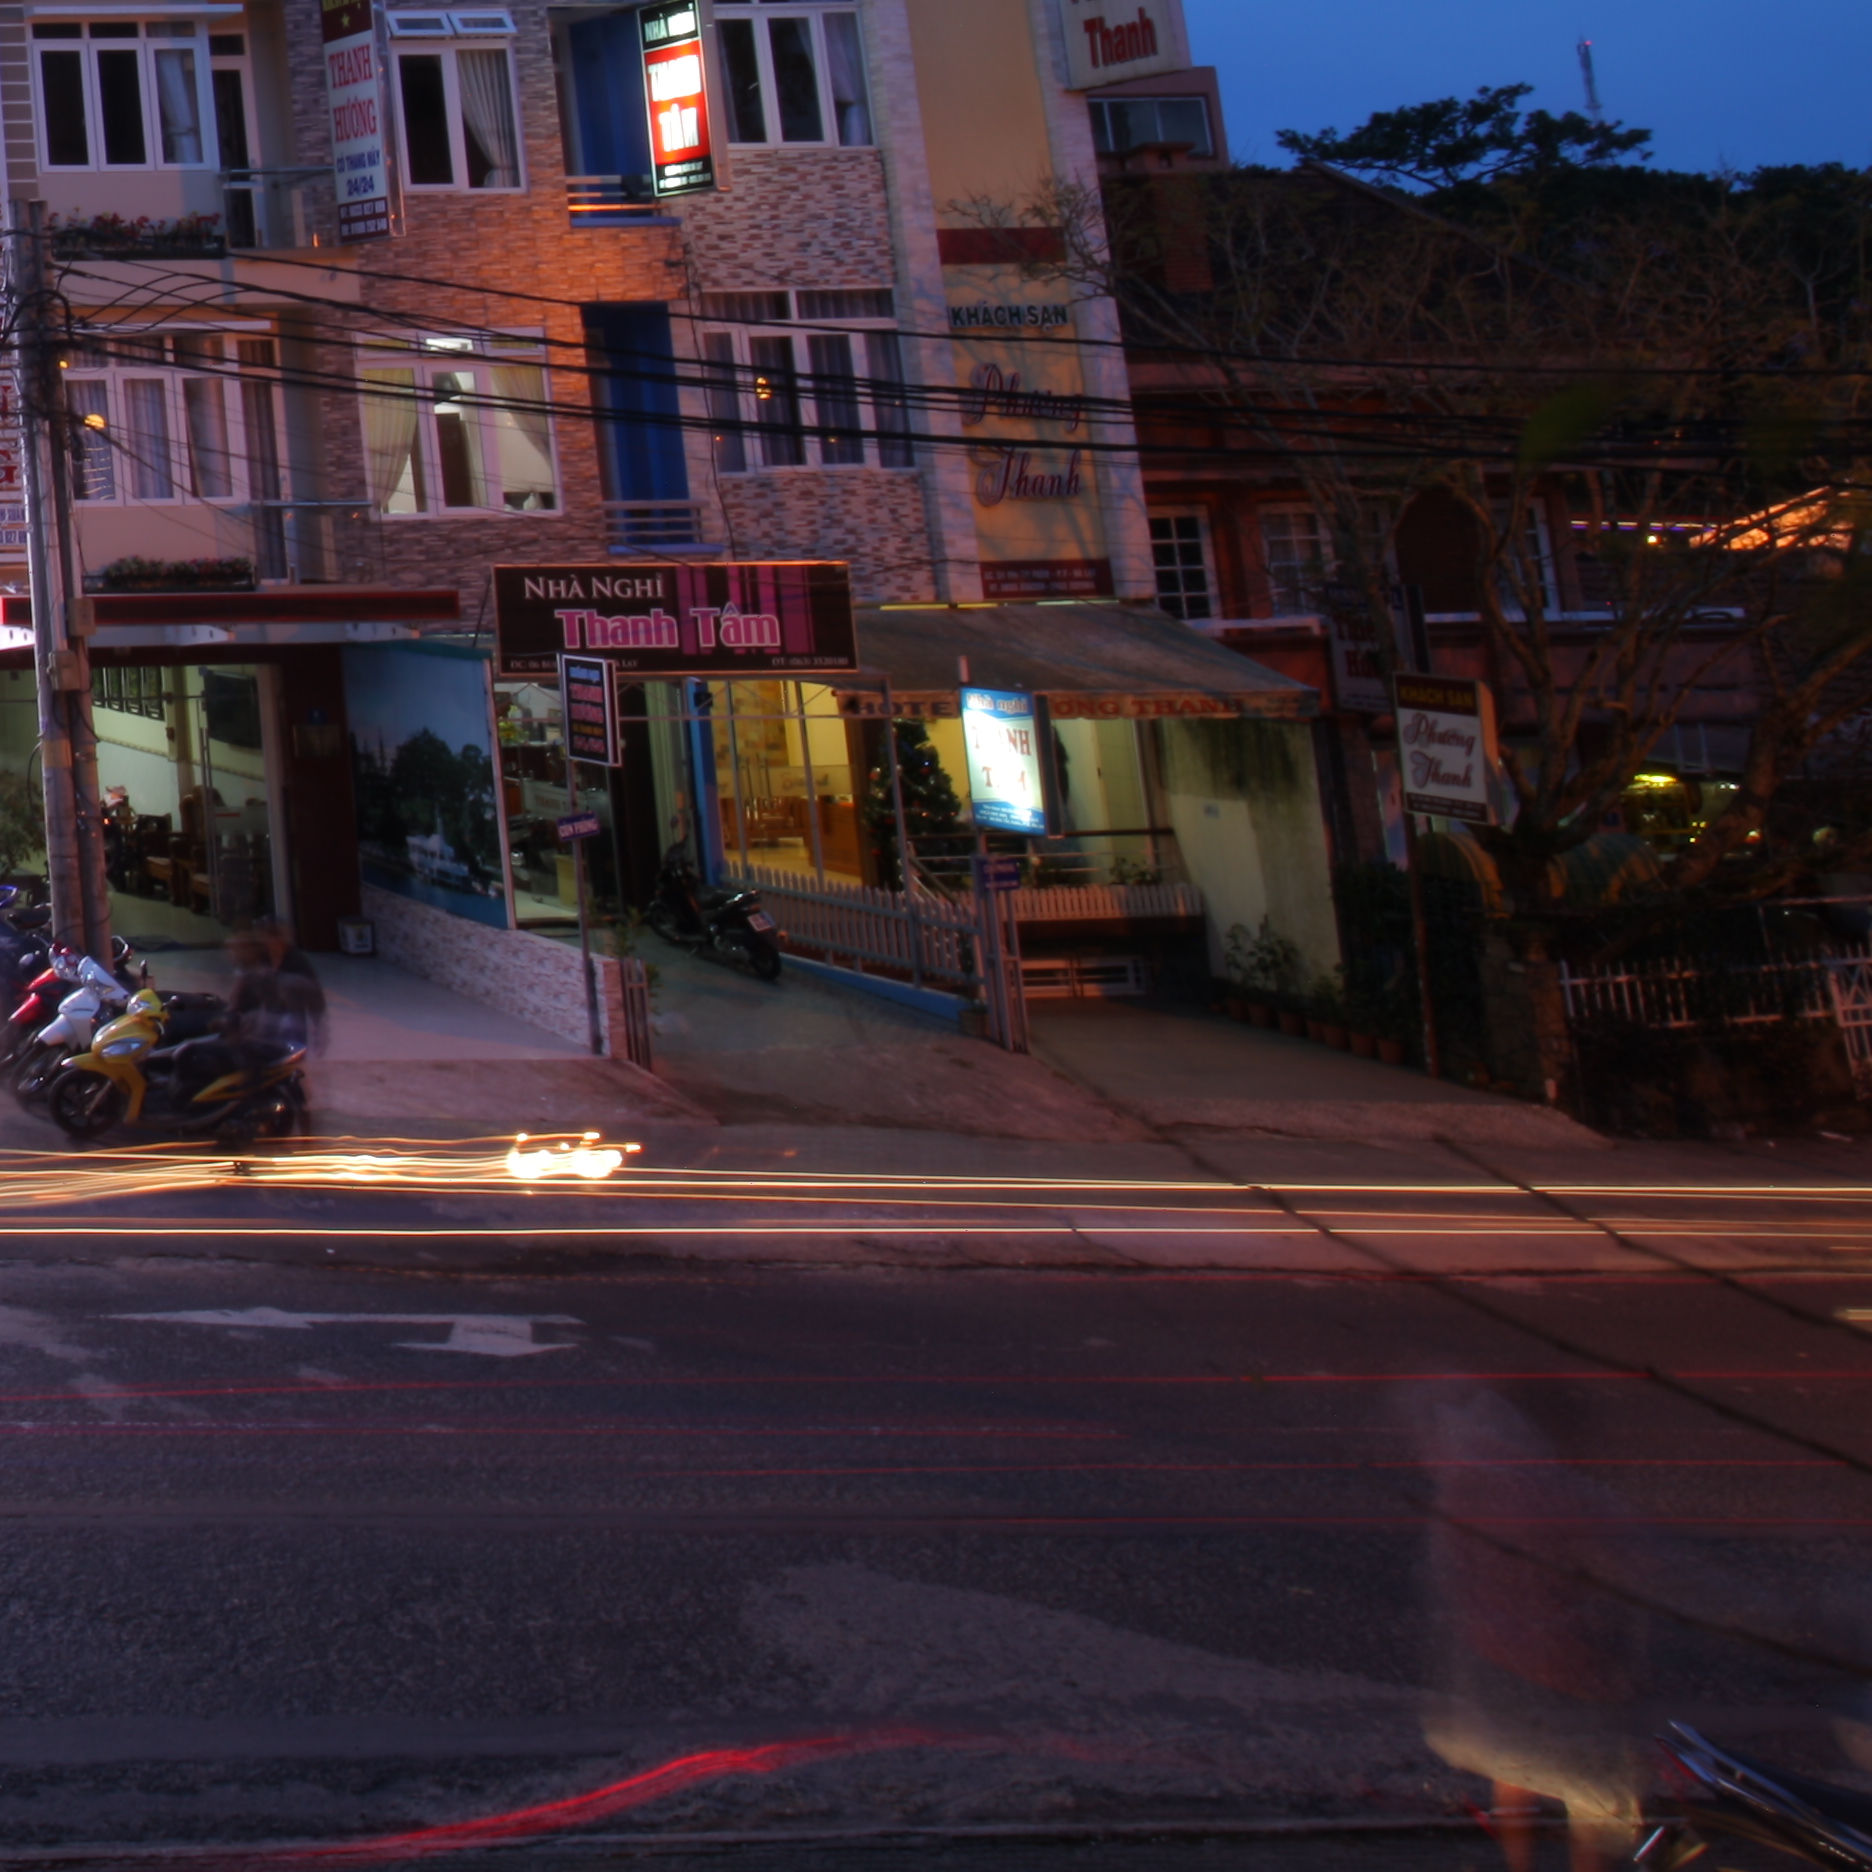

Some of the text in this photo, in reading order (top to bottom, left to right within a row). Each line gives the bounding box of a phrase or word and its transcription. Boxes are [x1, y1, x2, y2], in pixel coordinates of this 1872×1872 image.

[1083, 6, 1158, 69] Thanh
[328, 44, 373, 89] THANH
[951, 300, 1068, 332] KHÁCH SẠN
[524, 573, 664, 600] NHÀ NGHỈ
[554, 601, 781, 649] Thanh Tâm
[856, 700, 953, 718] HOTE
[1132, 698, 1244, 715] THANH
[1400, 682, 1444, 705] KHÁCH
[1410, 749, 1473, 789] Thanh
